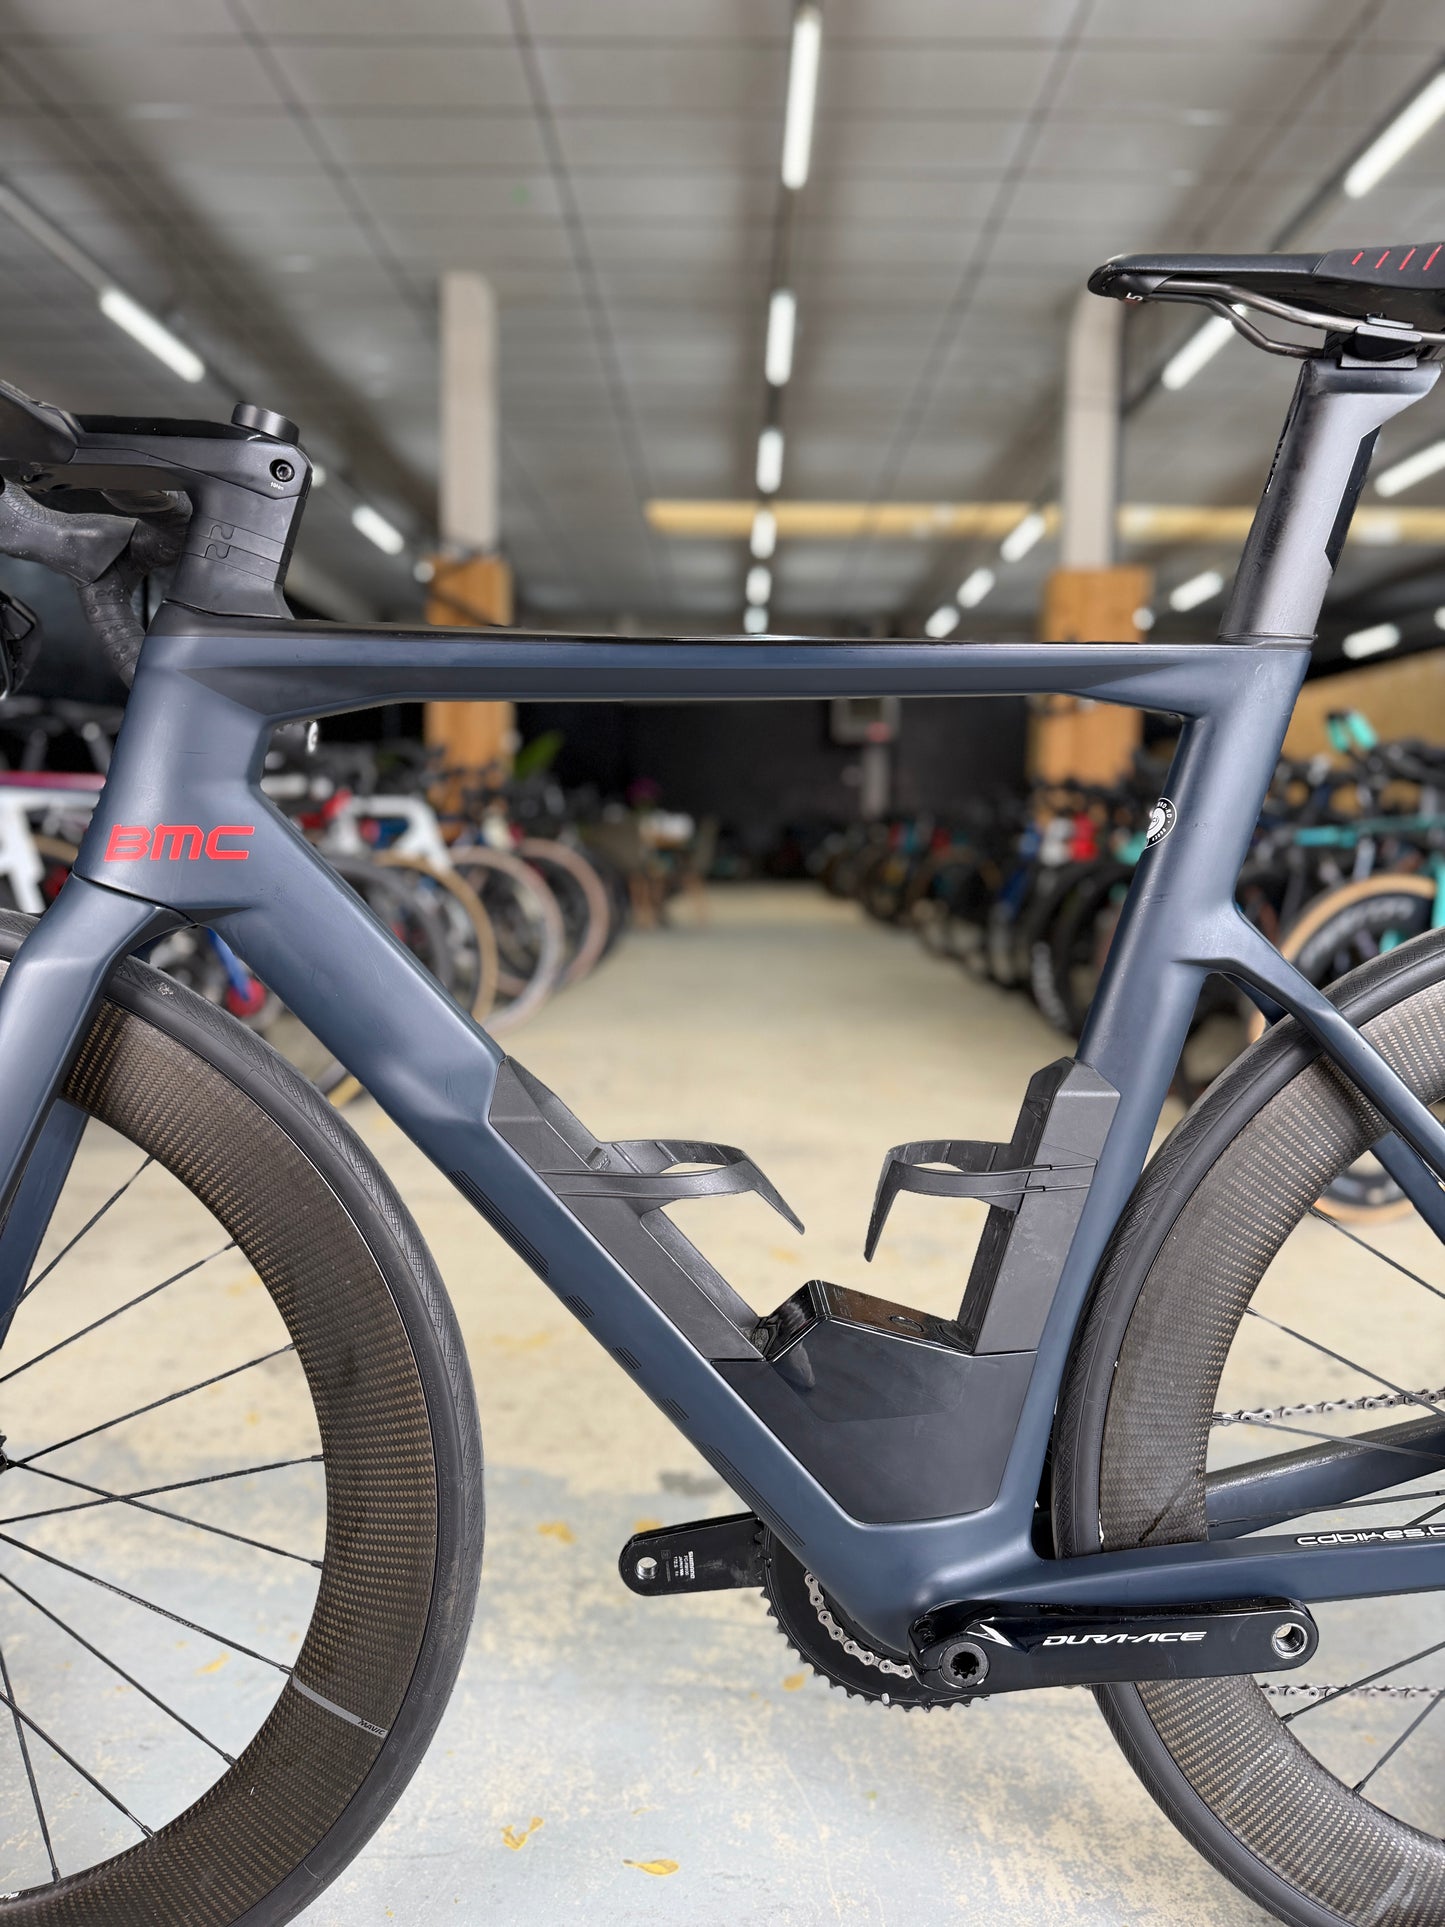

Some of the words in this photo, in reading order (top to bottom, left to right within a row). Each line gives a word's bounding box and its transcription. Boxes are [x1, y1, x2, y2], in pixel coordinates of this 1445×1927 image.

[103, 823, 255, 862] BMC
[1042, 1631, 1207, 1646] DURA-ACE
[358, 1719, 386, 1735] MAVIC
